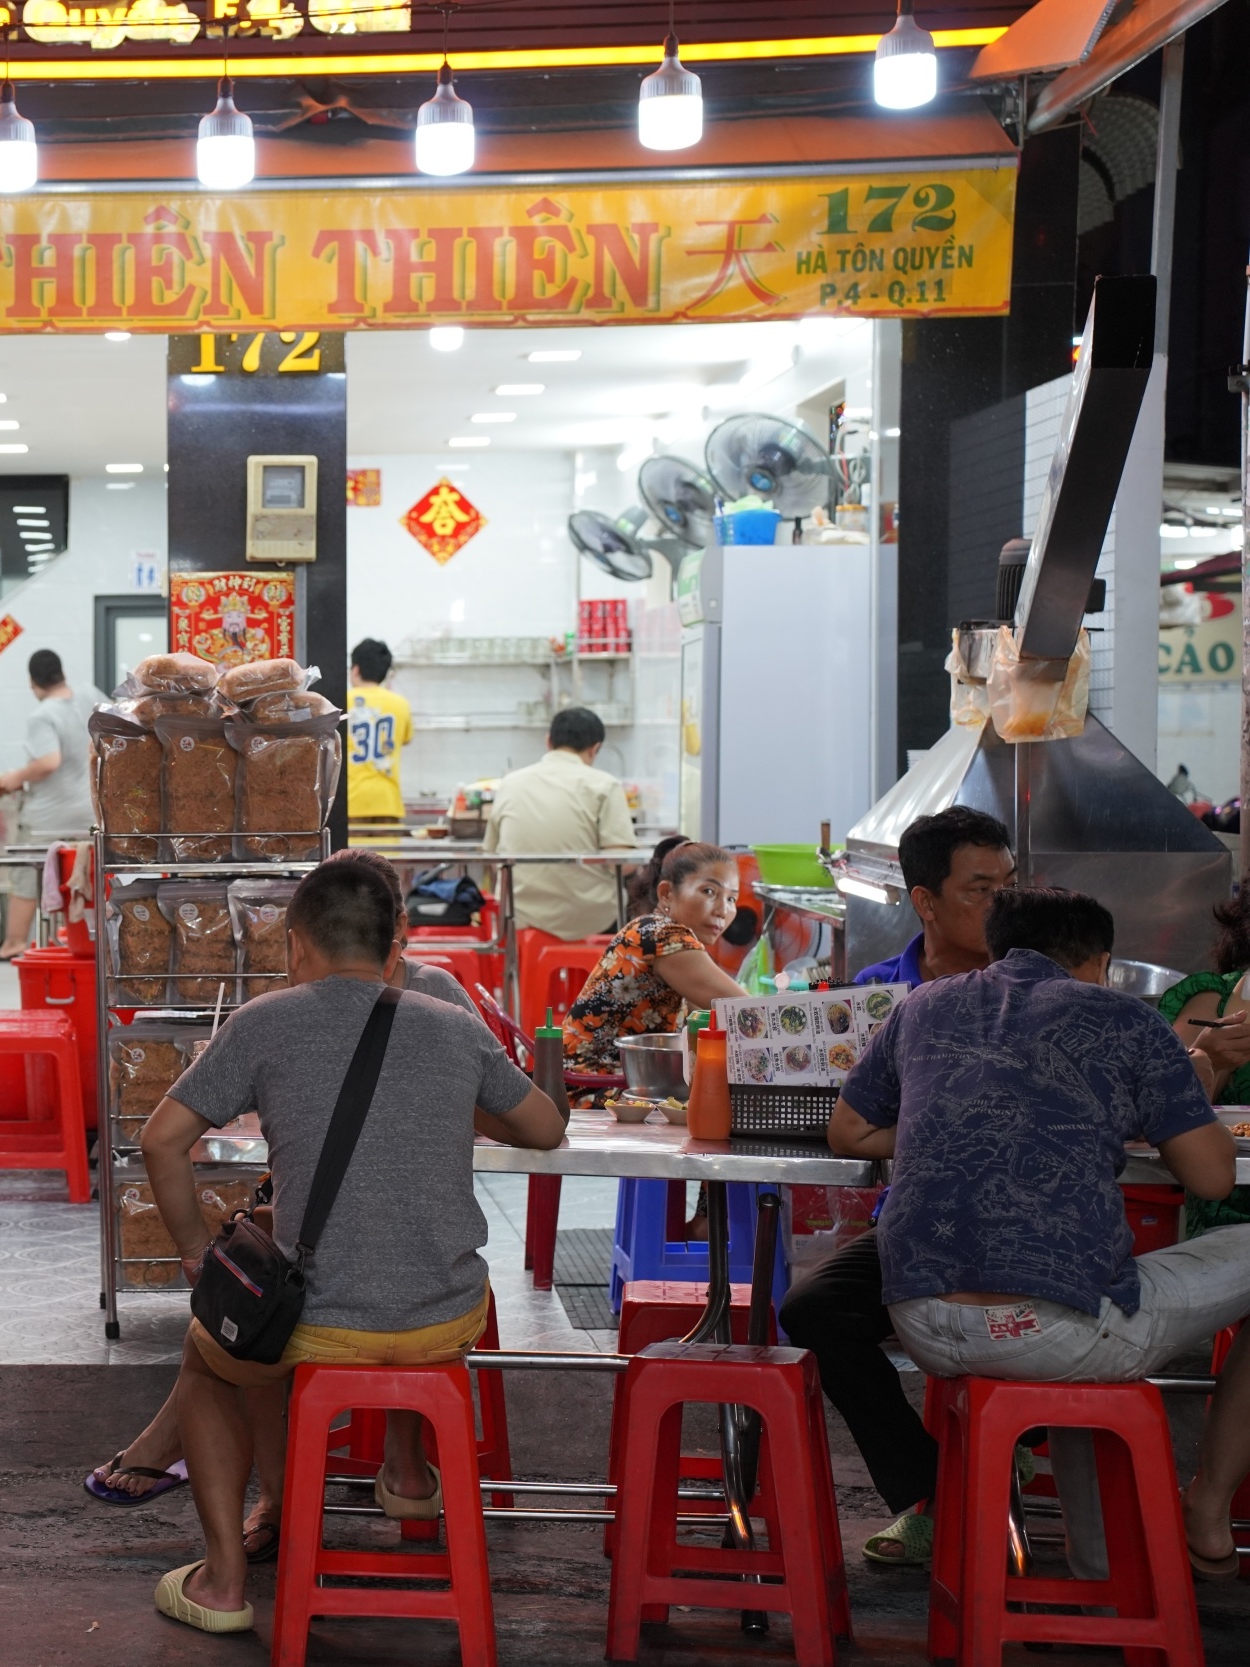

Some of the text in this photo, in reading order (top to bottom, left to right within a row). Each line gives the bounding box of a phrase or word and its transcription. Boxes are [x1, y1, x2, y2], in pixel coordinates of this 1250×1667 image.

[816, 183, 957, 235] 172
[311, 196, 666, 315] THIÊN
[684, 212, 786, 312] 天
[796, 234, 974, 275] HÀ TÔN QUYỀN
[819, 282, 861, 307] P.4
[887, 278, 947, 308] Q.11
[191, 331, 321, 373] 172
[352, 716, 394, 762] 30
[1047, 1123, 1096, 1131] MONTAUK
